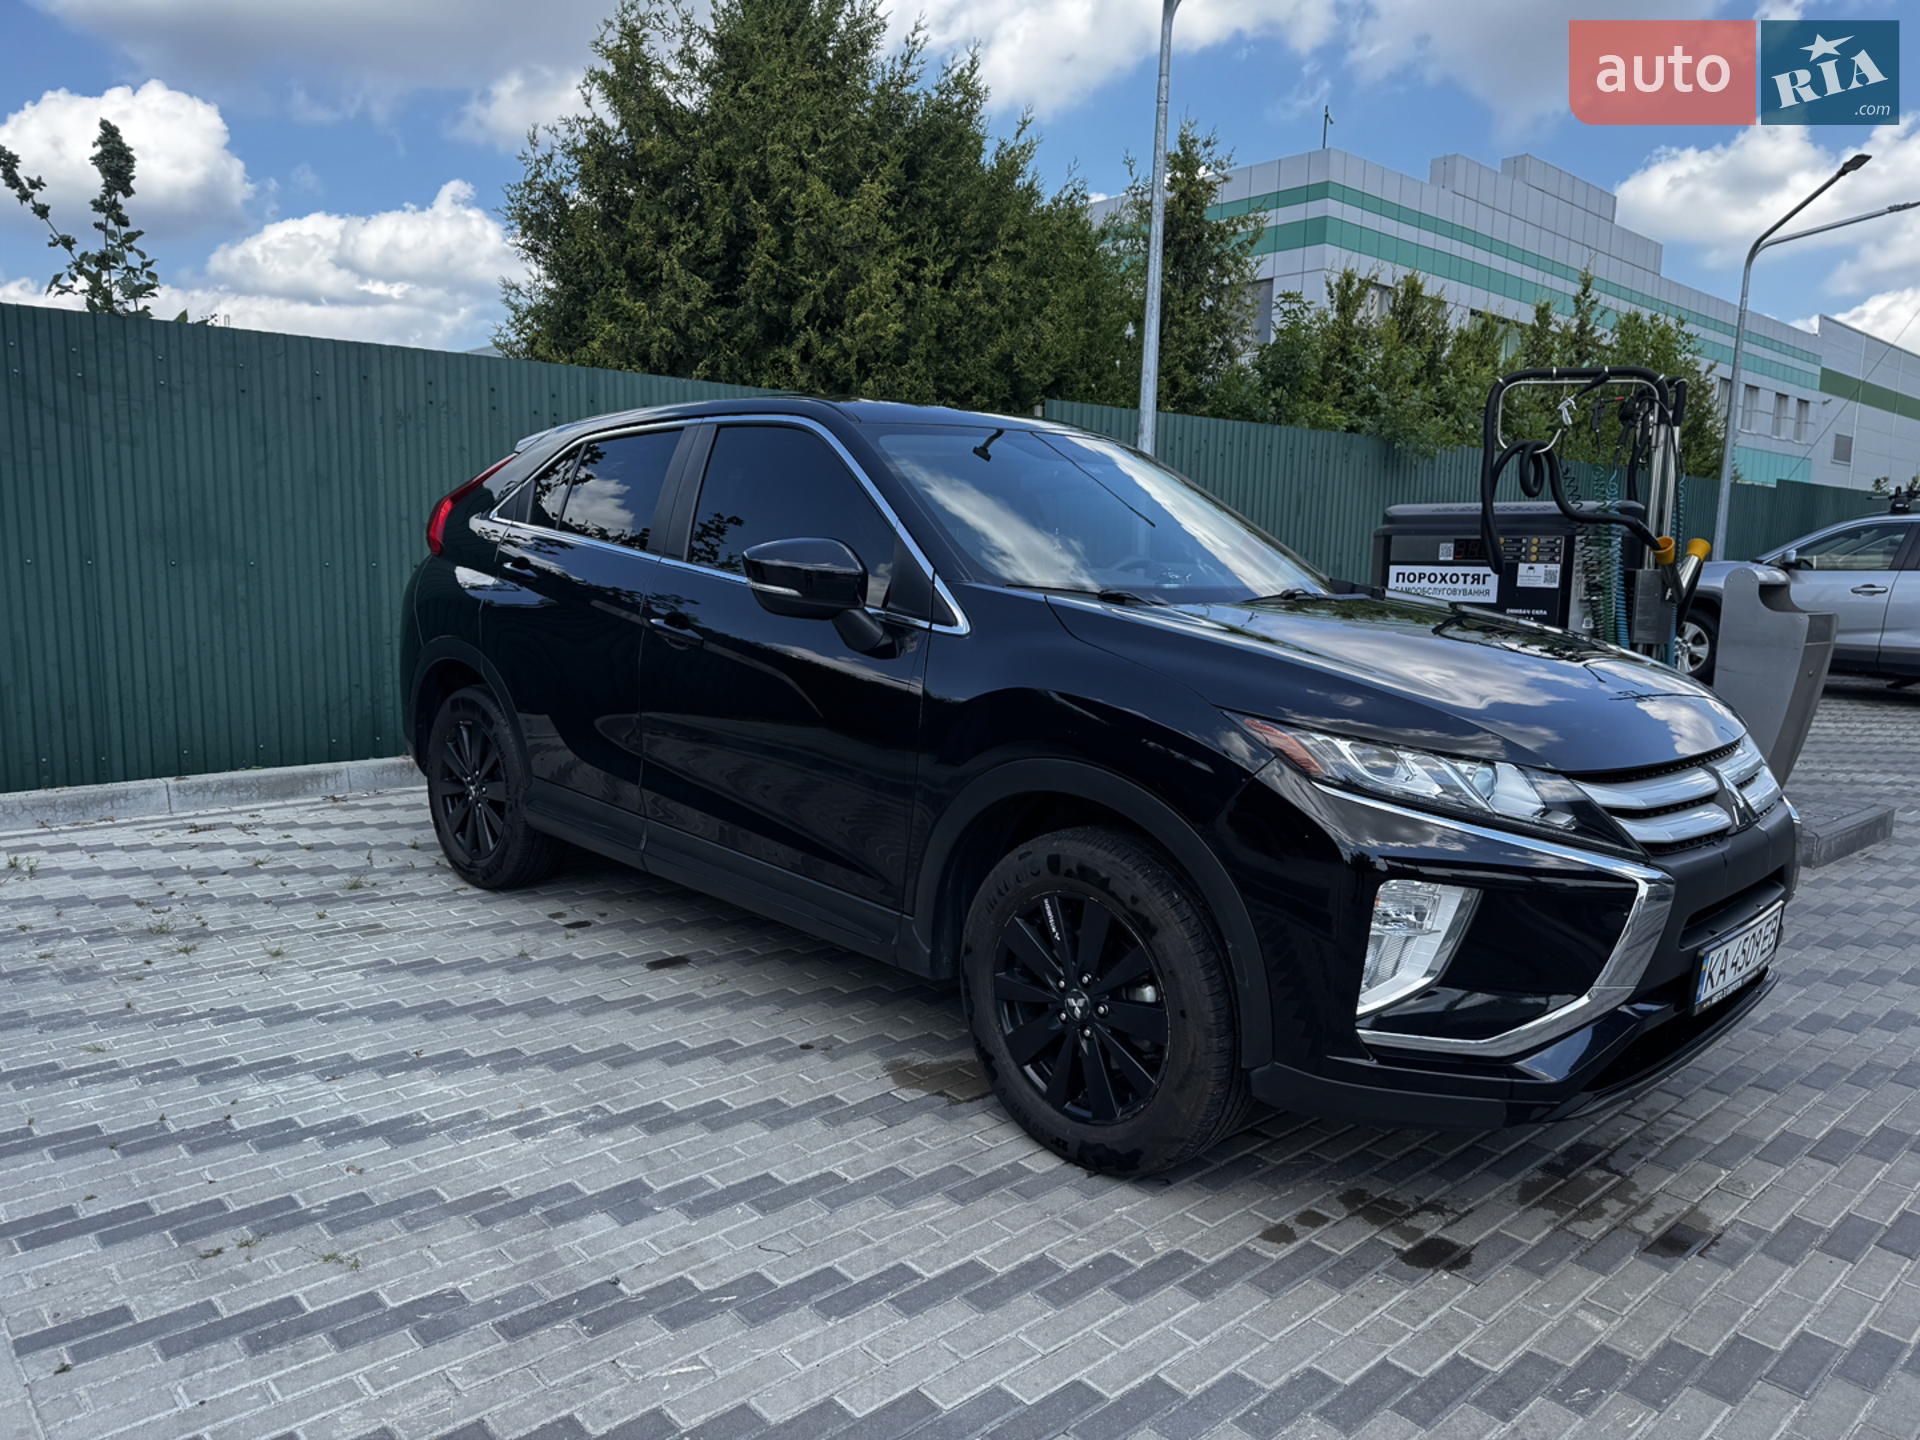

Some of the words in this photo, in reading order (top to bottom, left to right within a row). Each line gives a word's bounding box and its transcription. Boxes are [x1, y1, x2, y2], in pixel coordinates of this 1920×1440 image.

[1395, 571, 1492, 585] ПОРОХОТЯГ
[1703, 947, 1730, 995] KA
[1730, 926, 1763, 977] 4509
